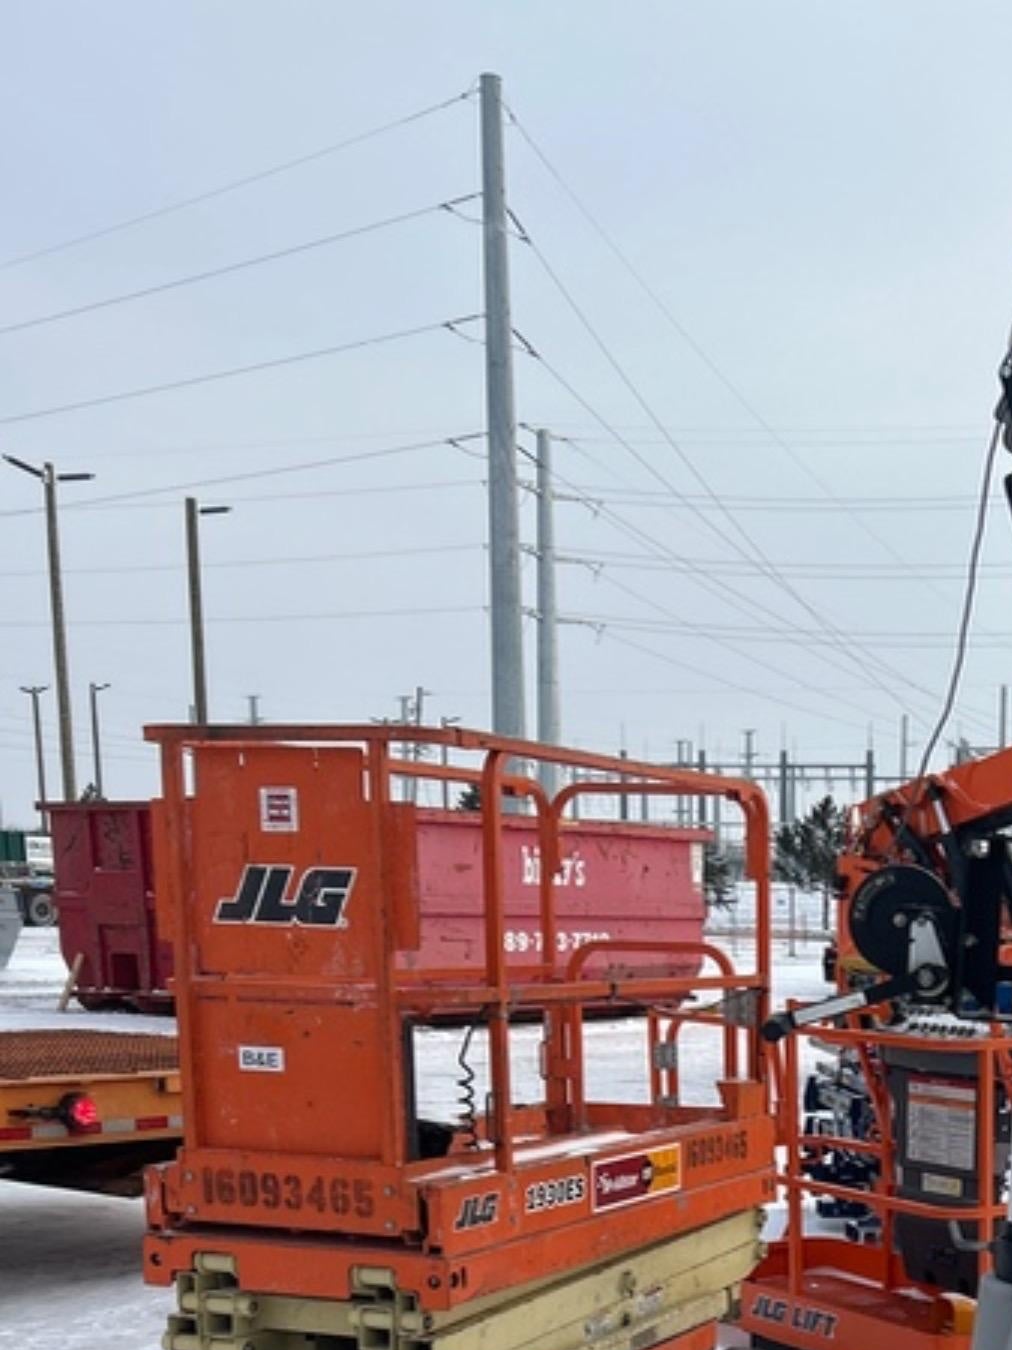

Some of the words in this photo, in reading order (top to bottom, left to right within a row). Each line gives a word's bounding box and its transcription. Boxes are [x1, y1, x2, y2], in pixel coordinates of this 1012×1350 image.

[213, 864, 357, 928] JLG
[241, 1050, 280, 1069] B&E
[202, 1166, 376, 1220] 16093465
[454, 1192, 499, 1231] JLG
[752, 1294, 787, 1323] JLG
[790, 1300, 838, 1339] LIFT
